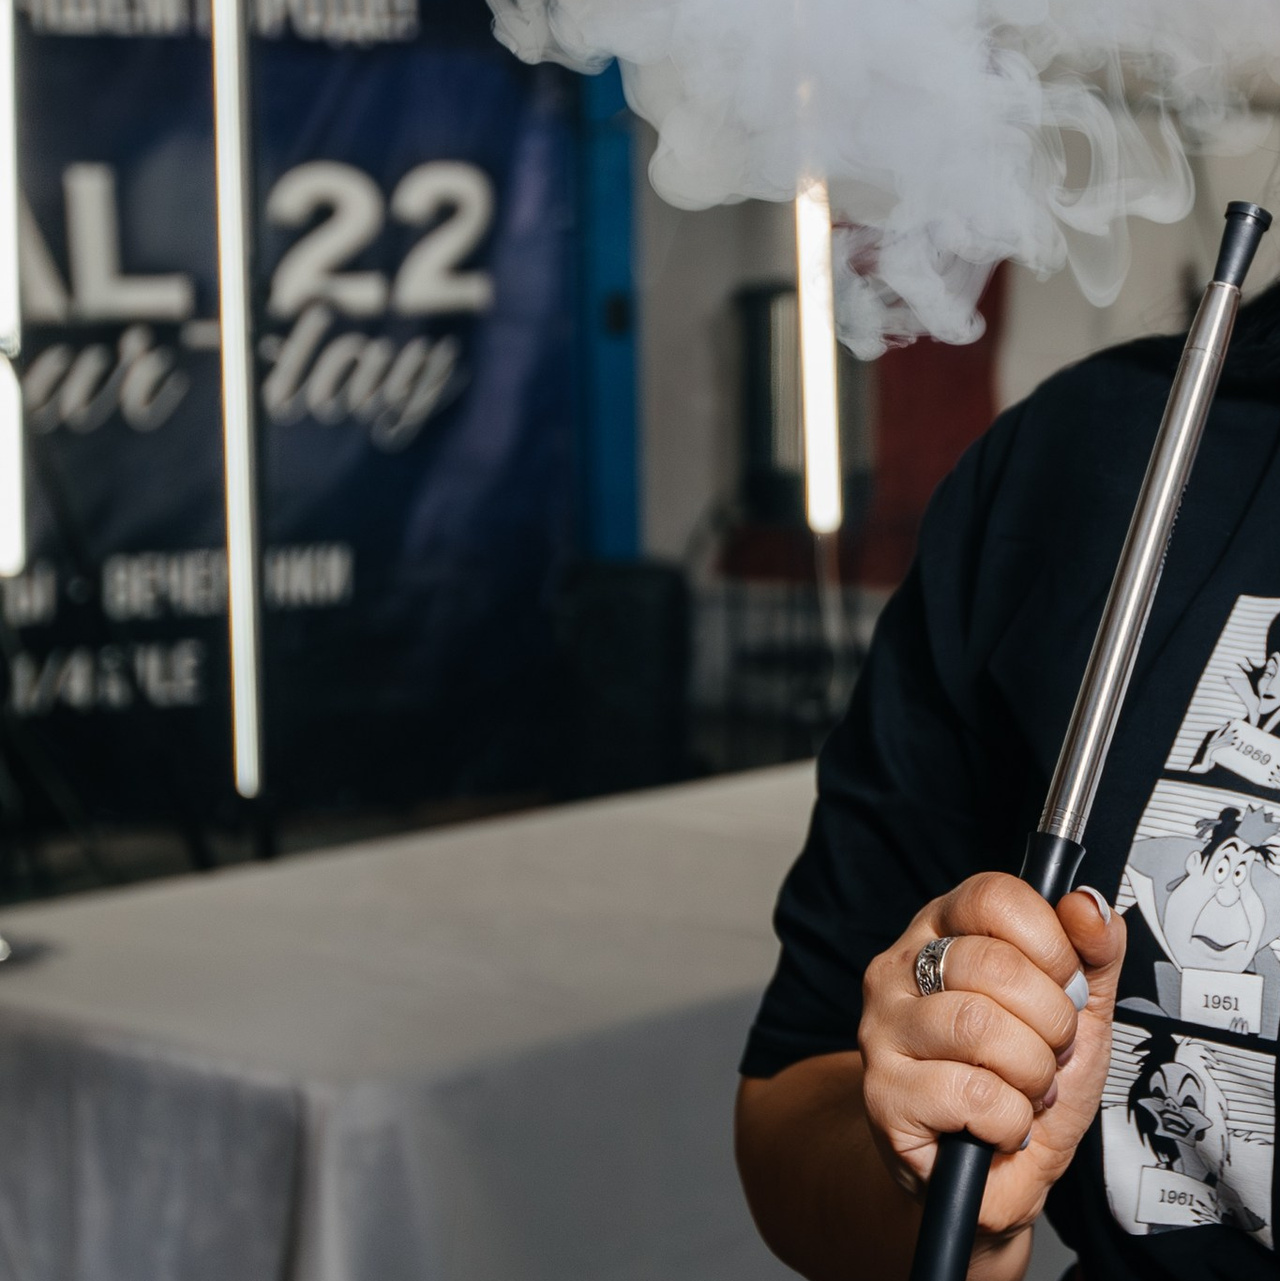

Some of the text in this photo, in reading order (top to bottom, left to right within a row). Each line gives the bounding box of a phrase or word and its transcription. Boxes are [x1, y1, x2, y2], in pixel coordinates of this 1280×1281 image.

[266, 160, 493, 320] 22
[1234, 741, 1273, 766] 1959
[1202, 994, 1240, 1011] 1951
[1158, 1188, 1195, 1206] 1961
